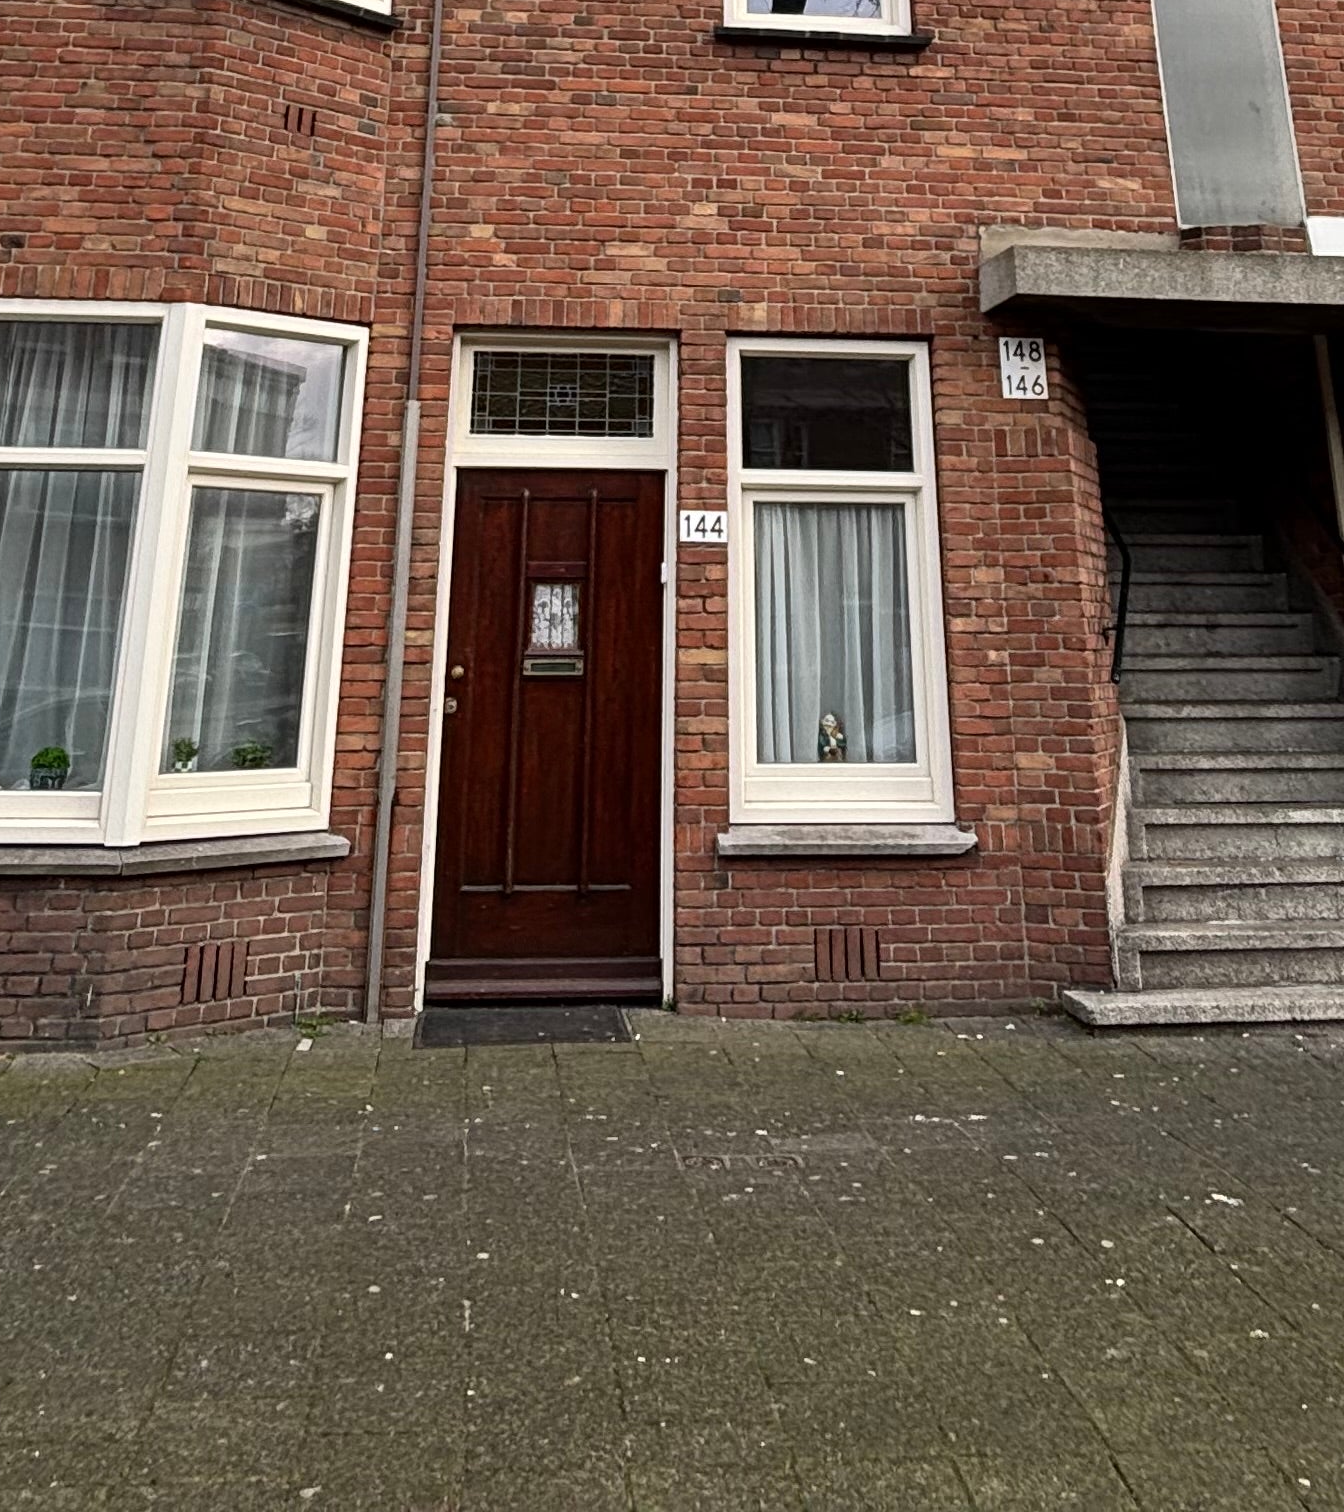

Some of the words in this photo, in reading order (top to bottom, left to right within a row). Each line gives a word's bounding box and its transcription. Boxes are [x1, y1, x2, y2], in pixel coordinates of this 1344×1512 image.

[1002, 340, 1042, 362] 148
[1006, 374, 1045, 396] 146
[684, 514, 724, 539] 144
